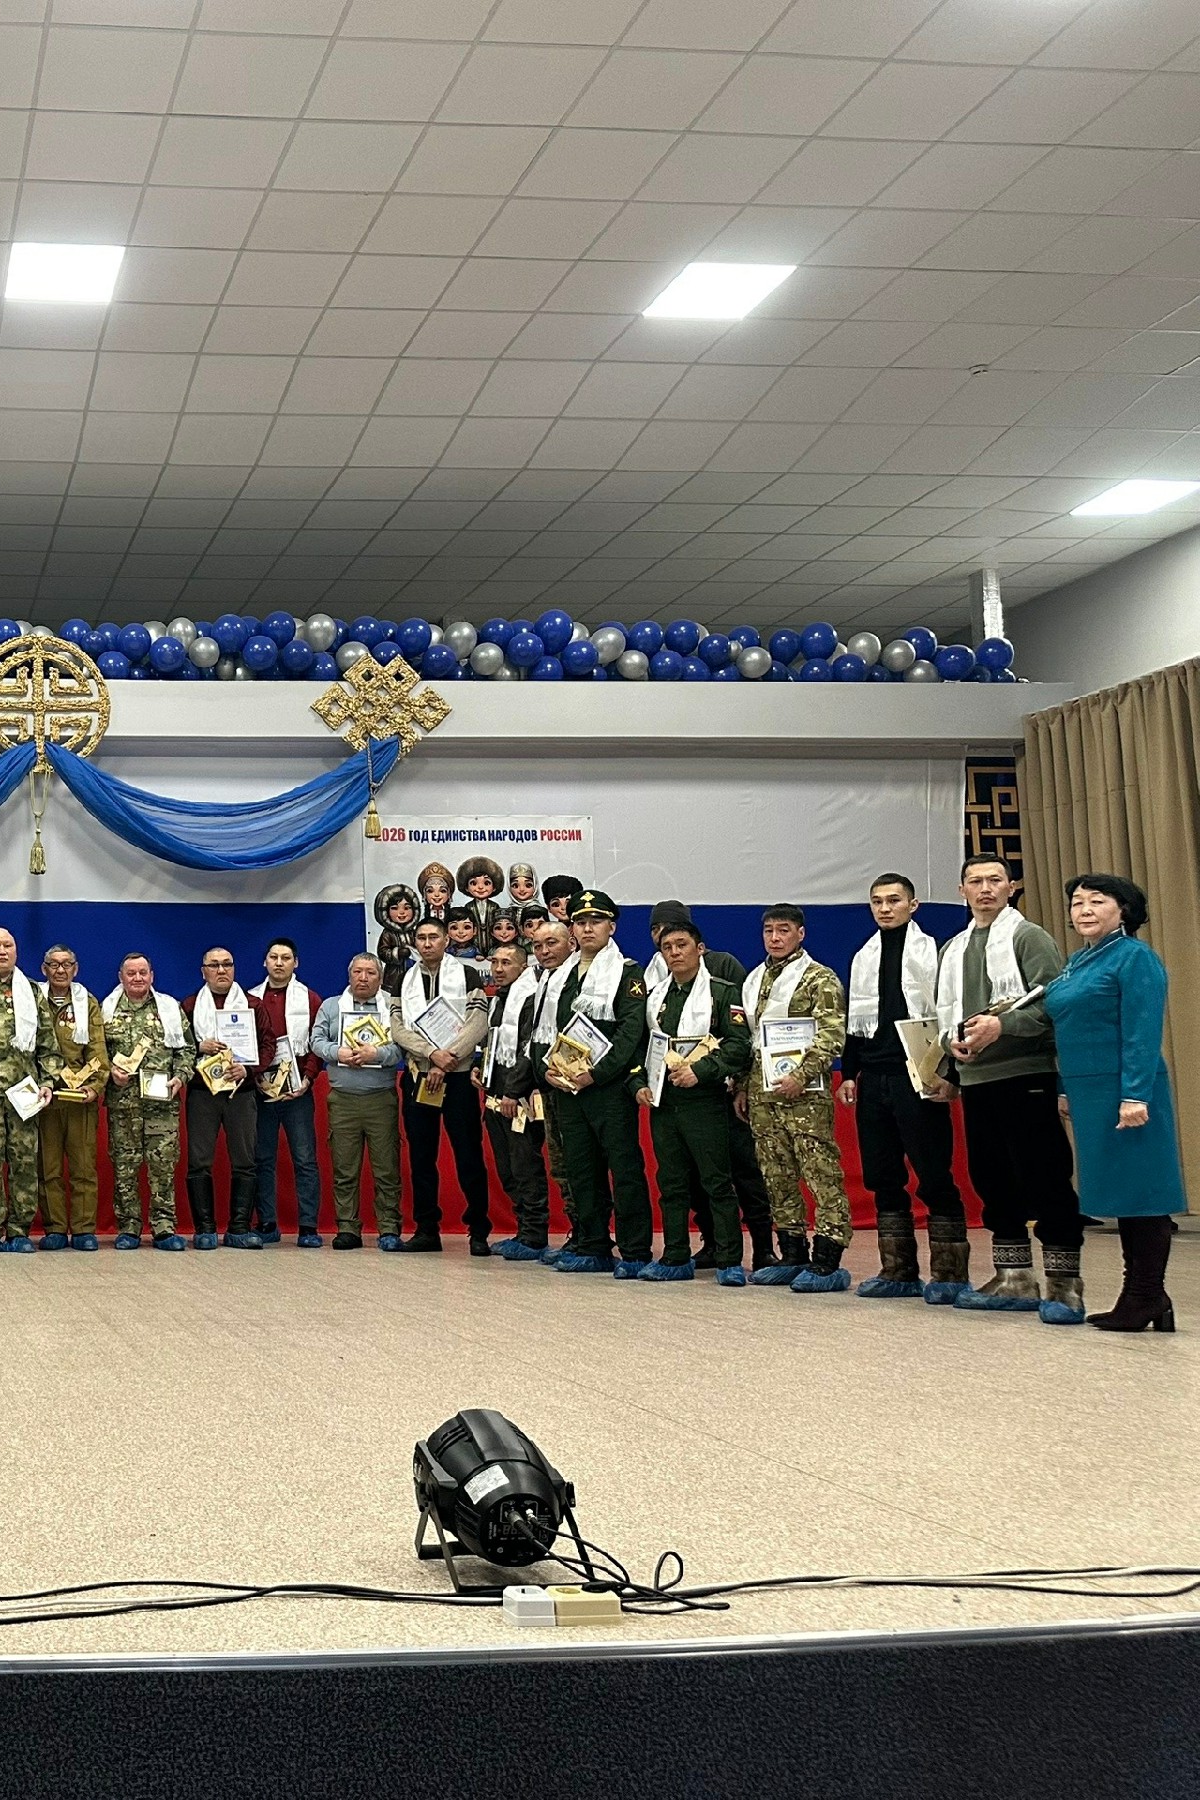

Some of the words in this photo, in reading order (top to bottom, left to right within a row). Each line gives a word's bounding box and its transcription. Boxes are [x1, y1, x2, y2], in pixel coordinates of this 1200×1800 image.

[409, 830, 429, 843] ГОД
[432, 830, 486, 843] ЕДИНСТВА
[488, 830, 538, 843] НАРОДОВ
[540, 830, 582, 841] РОССИИ
